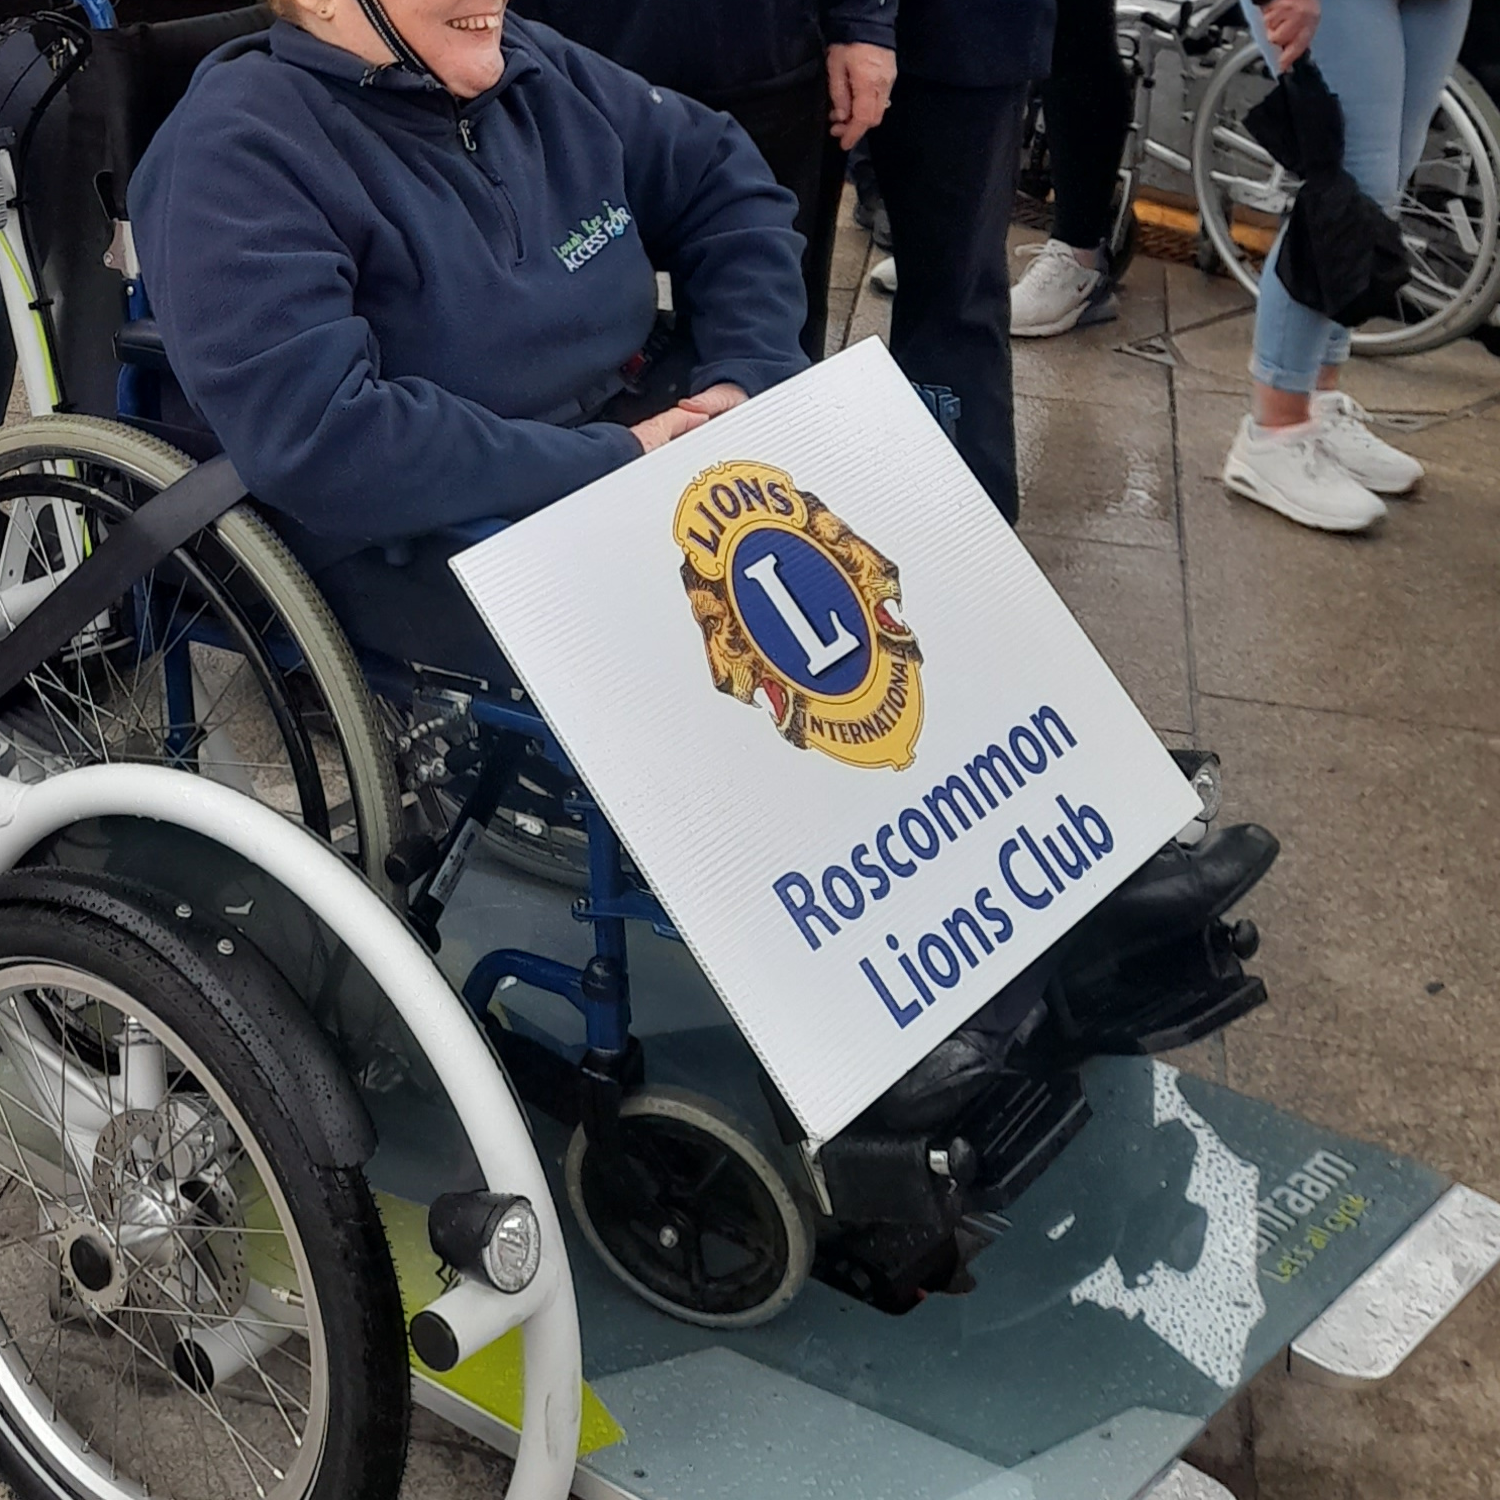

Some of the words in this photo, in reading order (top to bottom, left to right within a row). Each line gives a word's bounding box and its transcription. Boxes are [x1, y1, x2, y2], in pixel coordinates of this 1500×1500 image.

[563, 229, 608, 273] ACCESS
[603, 207, 631, 238] FOR
[687, 475, 795, 558] LIONS
[743, 553, 860, 678] L
[802, 649, 908, 745] INTERNATIONAL
[772, 705, 1078, 952] Roscommon
[858, 887, 1014, 1030] Lions
[998, 794, 1114, 910] Club
